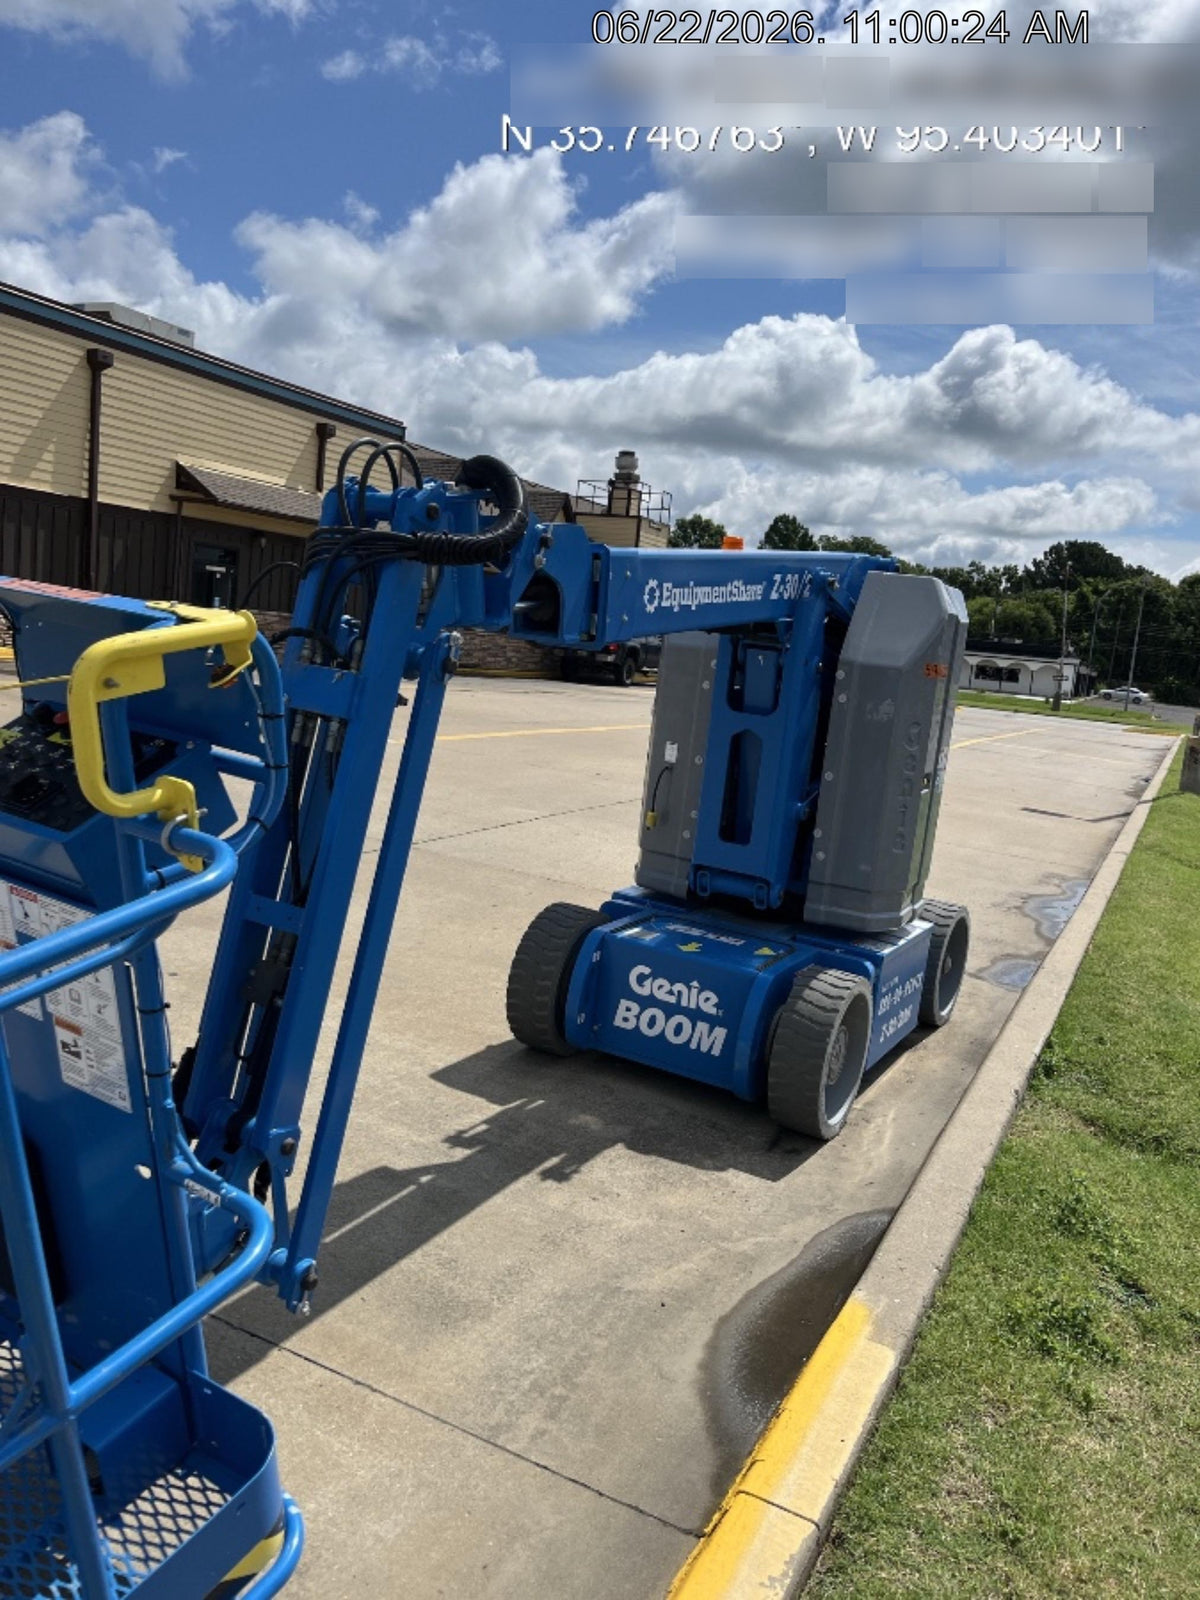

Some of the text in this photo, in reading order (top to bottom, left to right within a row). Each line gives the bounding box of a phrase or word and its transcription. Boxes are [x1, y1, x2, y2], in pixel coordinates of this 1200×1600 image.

[661, 580, 764, 612] EquipmentShare
[628, 965, 719, 1016] Genie
[613, 998, 728, 1057] BOOM
